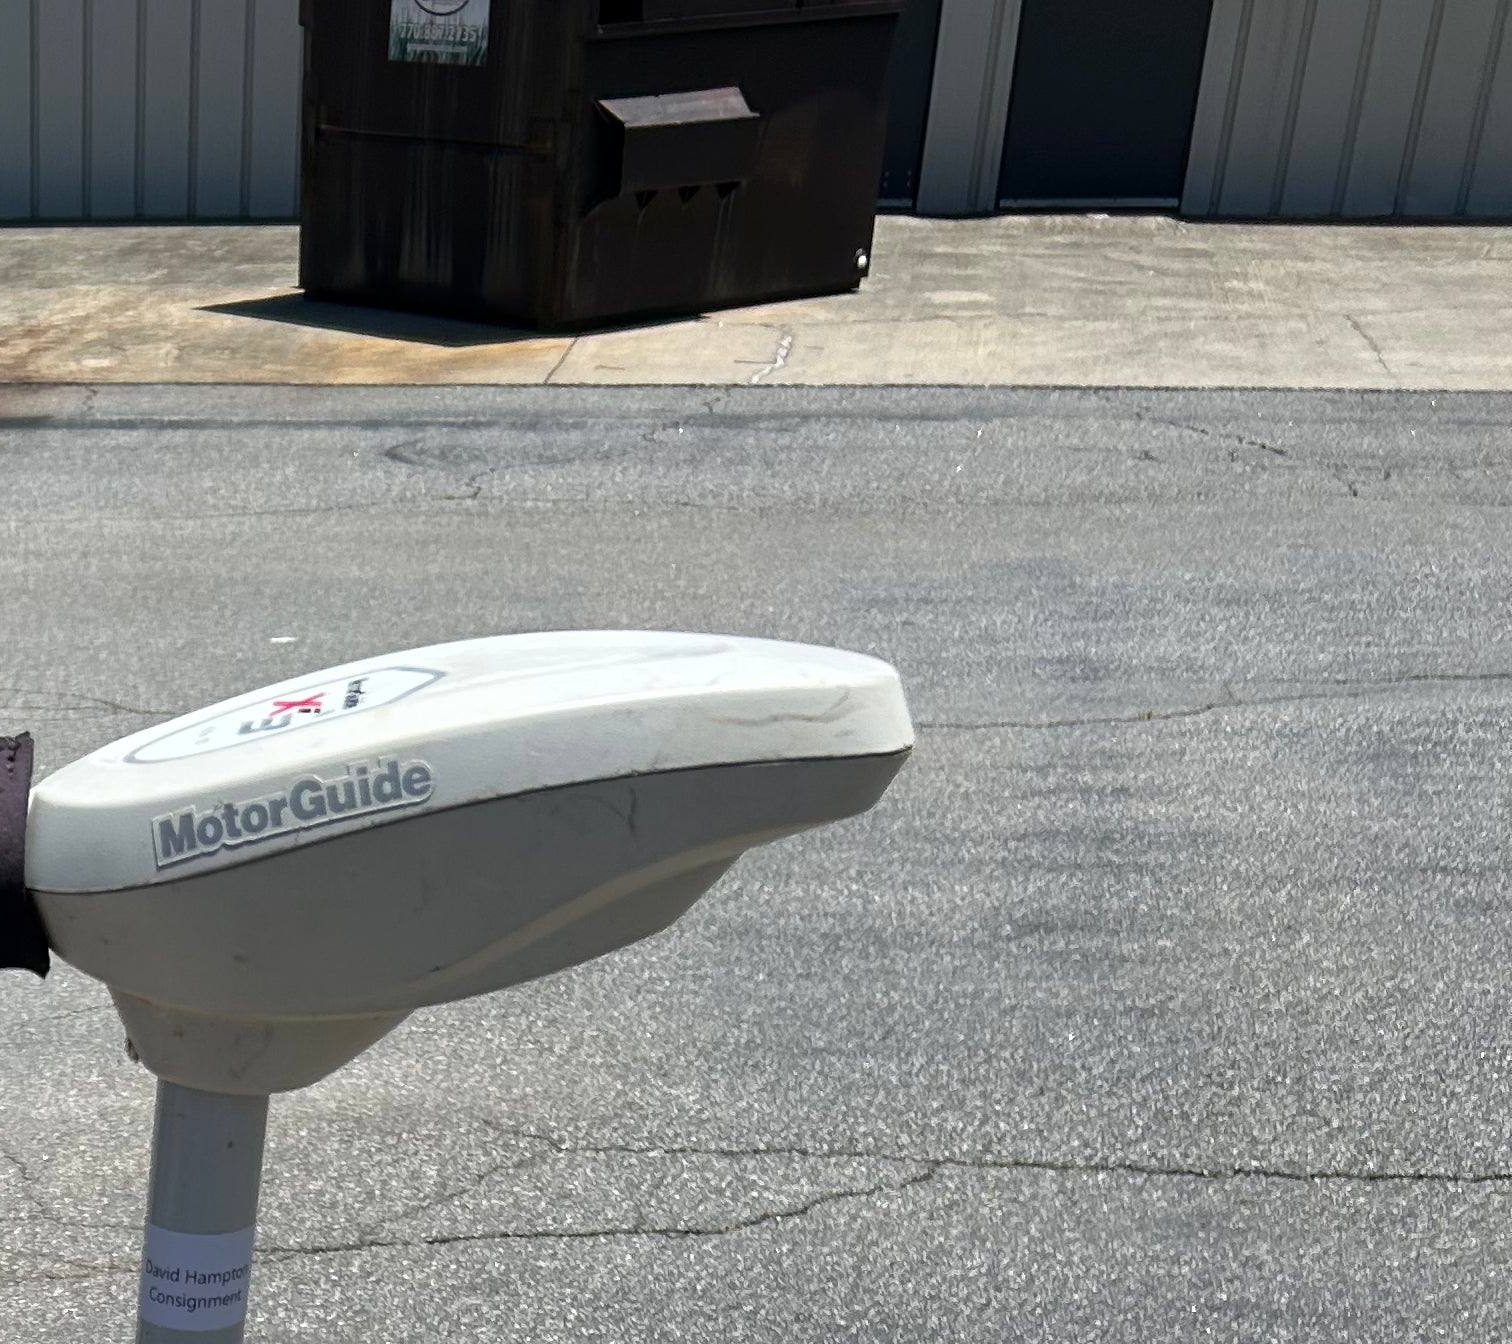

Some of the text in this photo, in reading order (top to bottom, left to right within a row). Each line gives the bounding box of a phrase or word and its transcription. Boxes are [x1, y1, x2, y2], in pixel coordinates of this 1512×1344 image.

[158, 758, 431, 857] MotorGuide
[145, 1259, 180, 1283] David
[149, 1286, 242, 1313] Consignment
